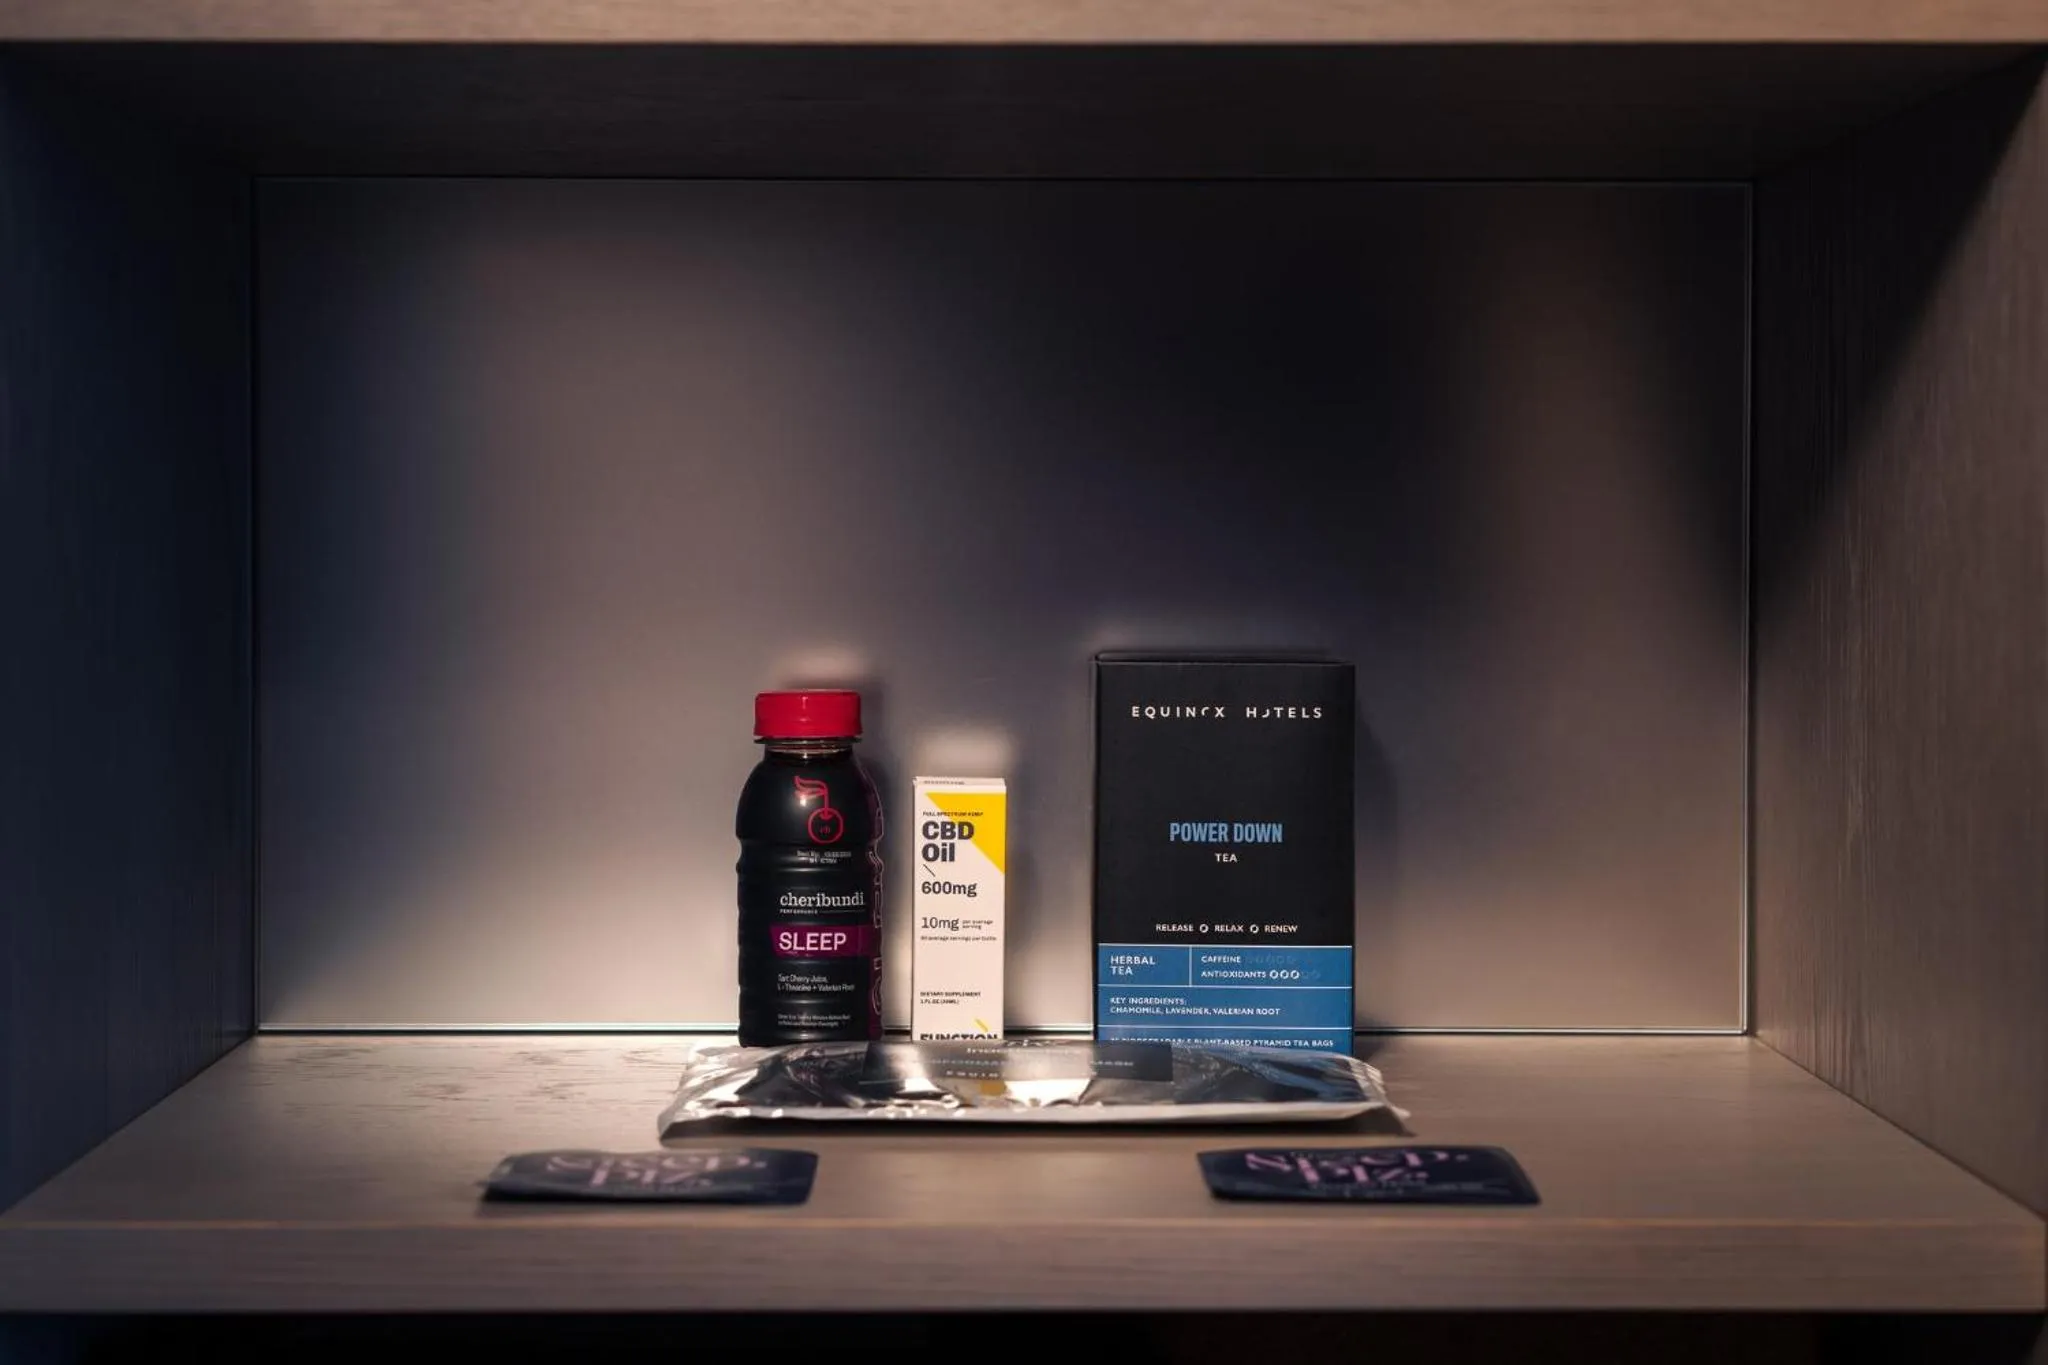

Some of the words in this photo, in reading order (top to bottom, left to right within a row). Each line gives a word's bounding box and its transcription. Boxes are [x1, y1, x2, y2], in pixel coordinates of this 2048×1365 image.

[922, 820, 975, 840] CBD
[1169, 822, 1229, 842] POWER
[1233, 823, 1283, 843] DOWN
[921, 842, 955, 862] Oil
[1215, 853, 1238, 862] TEA
[921, 881, 978, 898] 600mg
[780, 892, 864, 907] cheribundi
[921, 916, 960, 931] 10mg
[1156, 923, 1194, 932] RELEASE
[1214, 924, 1244, 932] RELAX
[1264, 924, 1298, 933] RENEW
[779, 932, 847, 951] SLEEP
[1110, 955, 1156, 965] HERBAL
[1110, 966, 1133, 976] TEA
[1201, 970, 1267, 978] ANTIOXIDANTS
[1110, 1007, 1164, 1015] CHAMOMILE,
[1166, 1007, 1212, 1015] LAVENDER,
[1253, 1039, 1291, 1047] PYRAMID
[1293, 1039, 1309, 1047] TEA
[1311, 1039, 1334, 1048] BAGS
